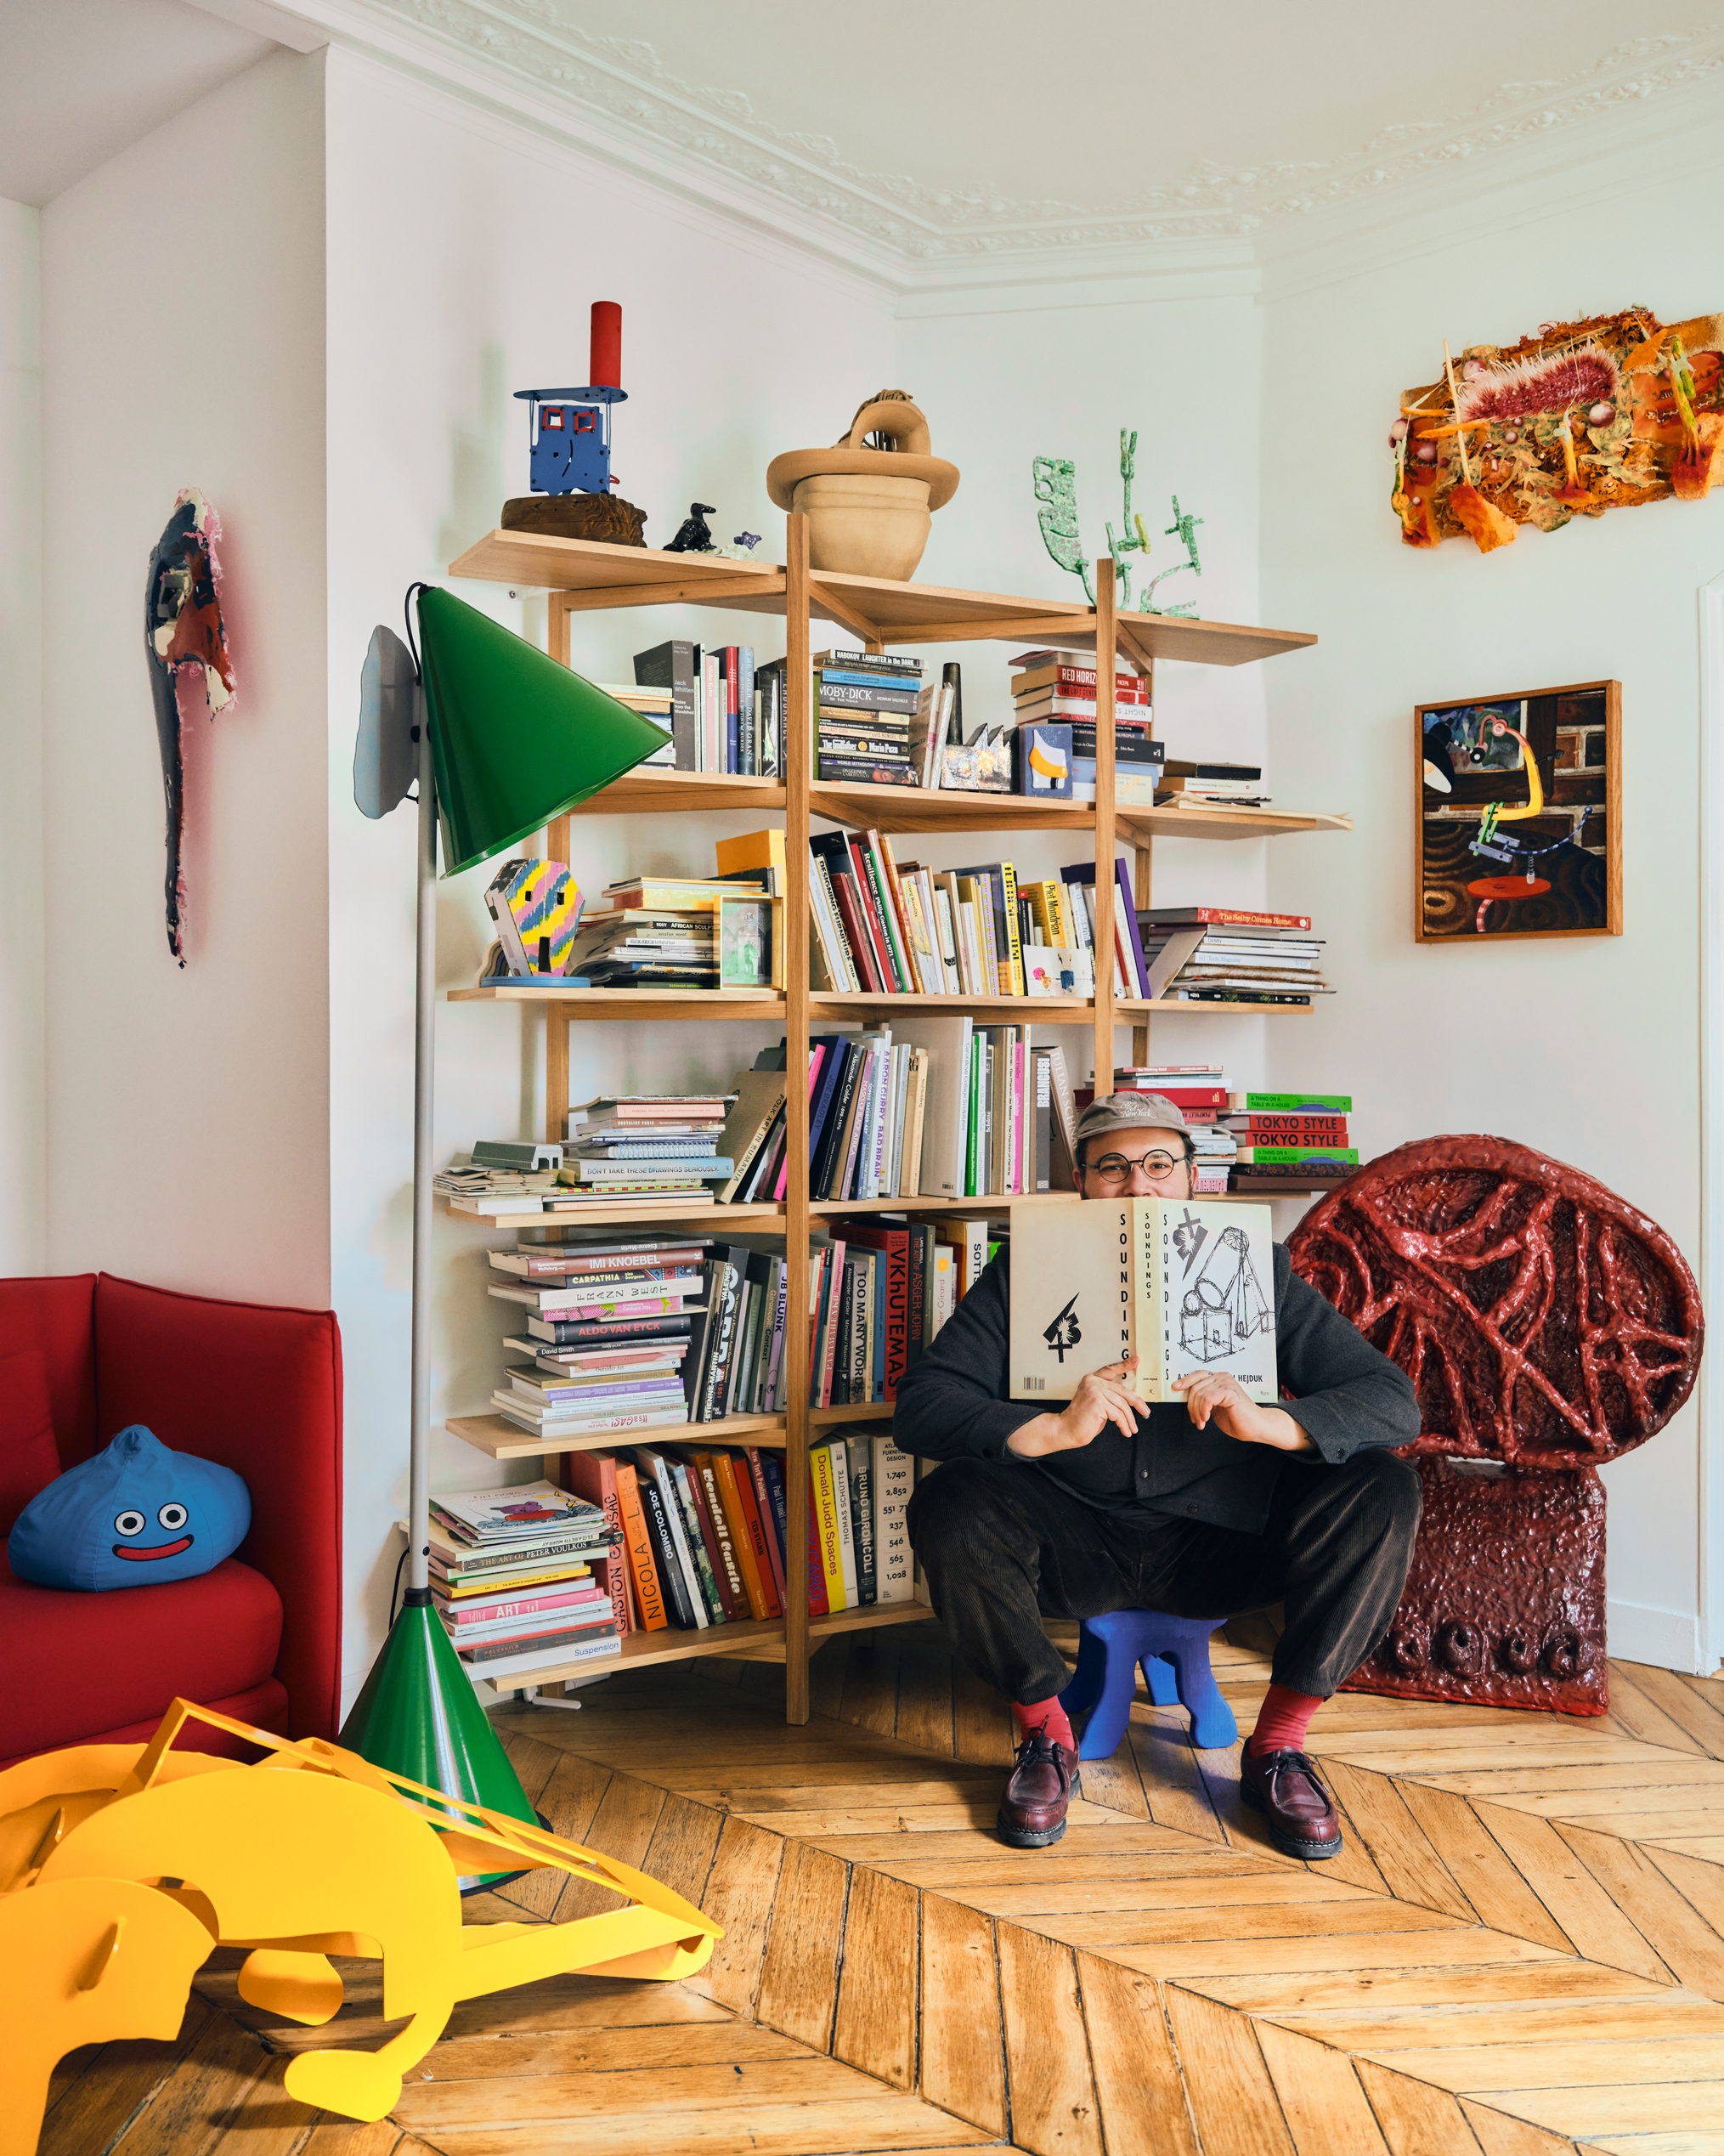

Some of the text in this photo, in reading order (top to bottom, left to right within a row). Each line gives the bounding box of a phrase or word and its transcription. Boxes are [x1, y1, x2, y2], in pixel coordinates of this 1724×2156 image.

[837, 651, 860, 660] NABOKOV
[862, 654, 887, 663] LAUGHTER
[1062, 668, 1096, 685] RED HORIZ
[819, 685, 873, 700] MOBY-DICK
[822, 739, 898, 753] The Godfather Mario Puzo
[864, 852, 878, 895] Resilience
[819, 861, 837, 911] DESIGNING
[834, 912, 851, 961] FURNITURE
[1045, 885, 1060, 935] Piet Mondrian
[1232, 914, 1250, 924] Selby
[1273, 916, 1291, 925] Home
[843, 1053, 858, 1104] Alexander Calder
[1037, 1057, 1049, 1107] BRANCUSI
[860, 1081, 868, 1100] MASKS
[1051, 1051, 1077, 1149] JULIAN SCHNA
[815, 1075, 834, 1130] JOE BRADLEY
[1137, 1108, 1156, 1118] York
[854, 1112, 863, 1130] BLACK
[1256, 1117, 1337, 1130] TOKYO STYLE
[733, 1094, 784, 1182] FOLK ART IN RUMANIA
[851, 1132, 859, 1155] AFRICA
[1252, 1134, 1338, 1146] TOKYO STYLE
[590, 1255, 660, 1269] IMI KNOEBEL
[573, 1274, 619, 1284] CARPATHIA
[721, 1265, 732, 1301] VALENCE
[913, 1272, 923, 1309] ASGER
[577, 1286, 668, 1301] FRANZ WEST
[775, 1276, 787, 1333] JB BLUNK
[1120, 1214, 1129, 1380] SOUNDINGS
[579, 1321, 660, 1336] ALDO VAN EYCK
[762, 1290, 777, 1361] Gironcoli: Context
[888, 1248, 907, 1387] VKhUTEMAS
[912, 1311, 922, 1340] JORN
[826, 1295, 839, 1370] PANAMARENKO
[855, 1270, 867, 1394] TOO MANY WORDS
[705, 1351, 719, 1419] ETIENNE-MARTIN
[717, 1365, 726, 1399] 1948-1951
[1238, 1374, 1263, 1383] HEJDUK
[886, 1471, 906, 1480] 1,740
[757, 1479, 766, 1502] Painting
[838, 1470, 847, 1508] SCHÜTTE
[886, 1488, 907, 1497] 2,852
[627, 1501, 640, 1519] L.
[818, 1455, 837, 1576] Donald Judd Spaces
[858, 1467, 872, 1573] BRUNO GIRONCOLI
[884, 1506, 896, 1514] 551
[649, 1490, 673, 1560] JOE COLOMBO
[703, 1468, 740, 1594] Wendell Castle
[481, 1558, 497, 1566] THE
[498, 1555, 512, 1564] ART
[527, 1549, 550, 1559] PETER
[551, 1542, 587, 1554] VOULKOS
[754, 1533, 765, 1556] STAMM
[889, 1537, 903, 1548] 546
[890, 1555, 903, 1565] 565
[635, 1542, 661, 1620] NICOLA
[809, 1550, 823, 1599] CARO
[886, 1571, 907, 1581] 1,028
[496, 1603, 520, 1618] ART
[612, 1567, 626, 1632] GASTON
[484, 1644, 519, 1655] POLYPHILO
[574, 1642, 619, 1656] Suspension
